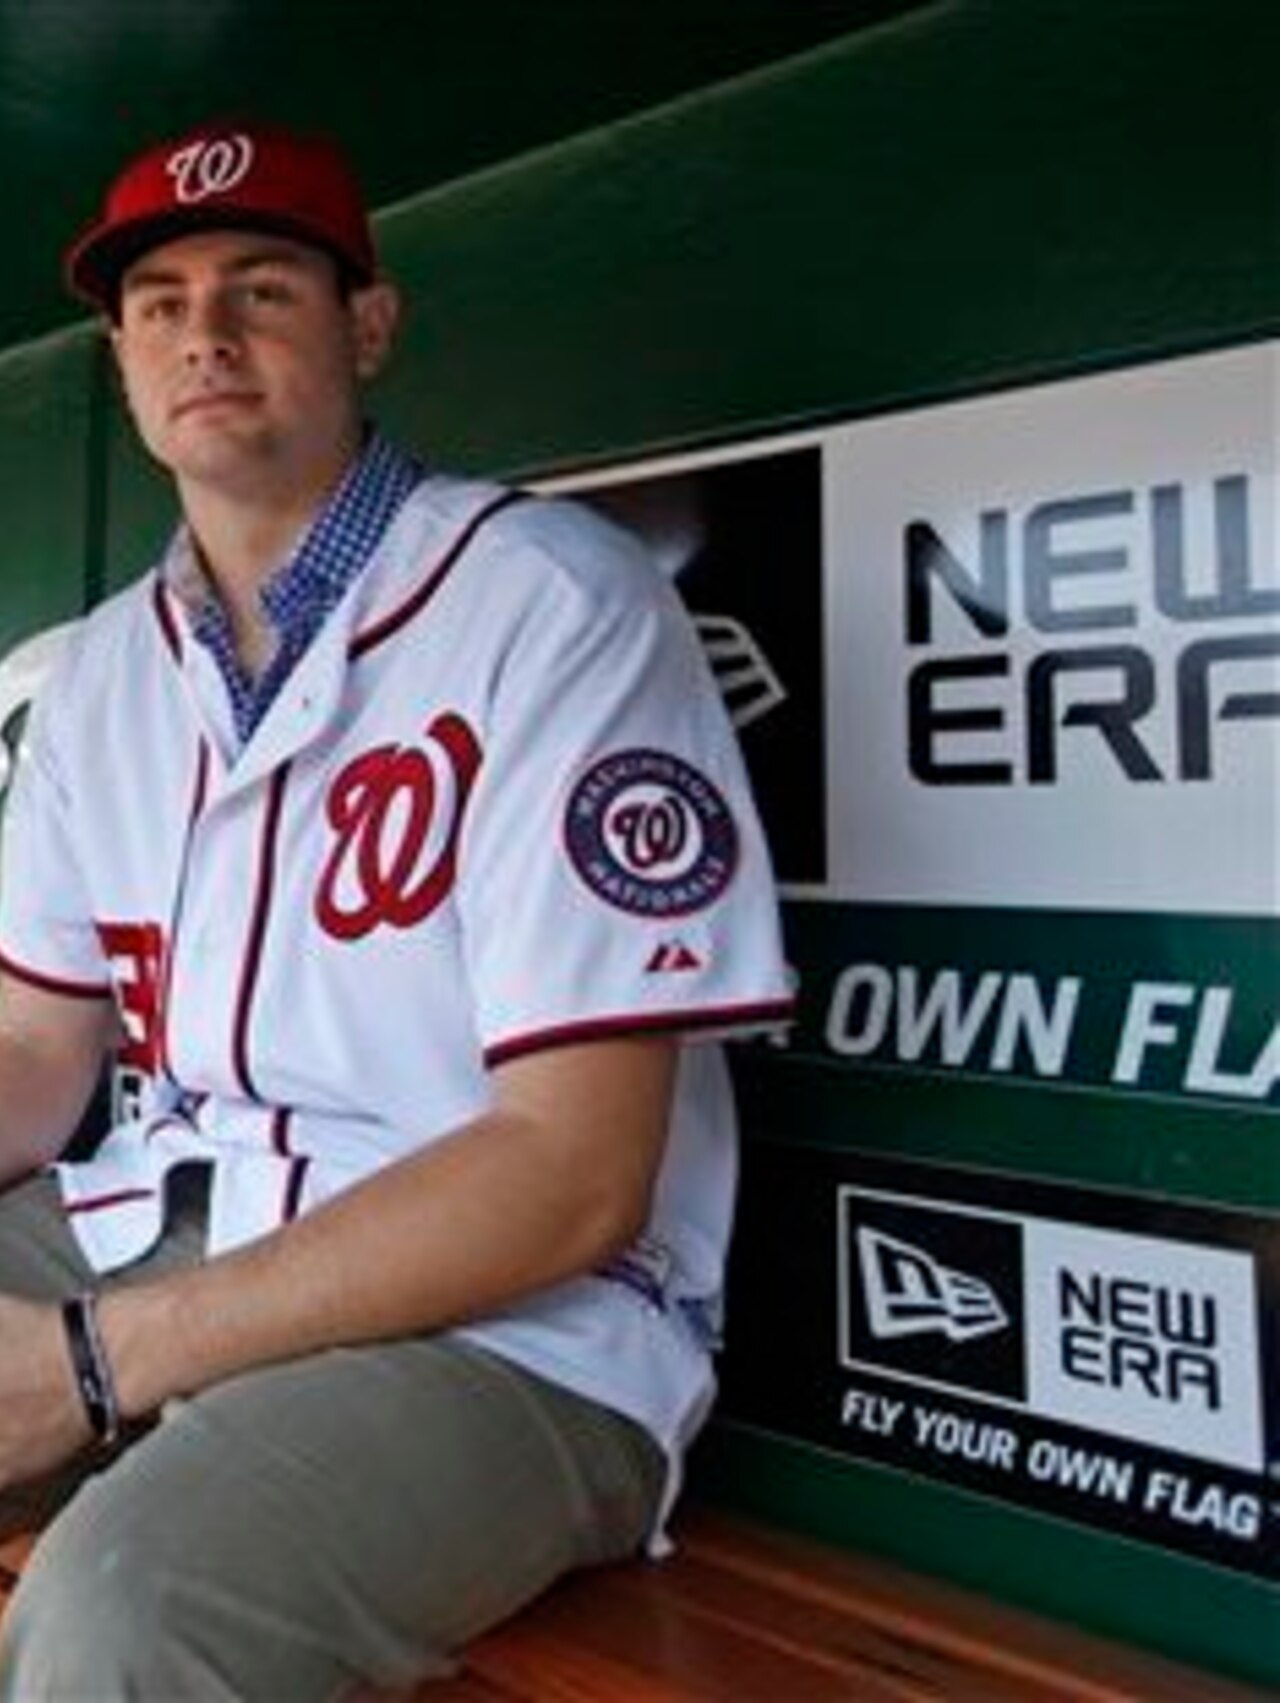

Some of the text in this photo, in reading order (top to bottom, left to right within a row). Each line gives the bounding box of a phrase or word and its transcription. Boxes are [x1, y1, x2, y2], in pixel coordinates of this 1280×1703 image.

[166, 133, 253, 203] W
[904, 473, 1280, 645] NEW
[907, 632, 1280, 787] ERA
[314, 709, 484, 943] W
[825, 963, 1082, 1077] OWN
[1058, 1266, 1218, 1350] NEW
[1059, 1324, 1222, 1411] ERA
[840, 1388, 1261, 1540] FLY YOUR OWN FLAG
